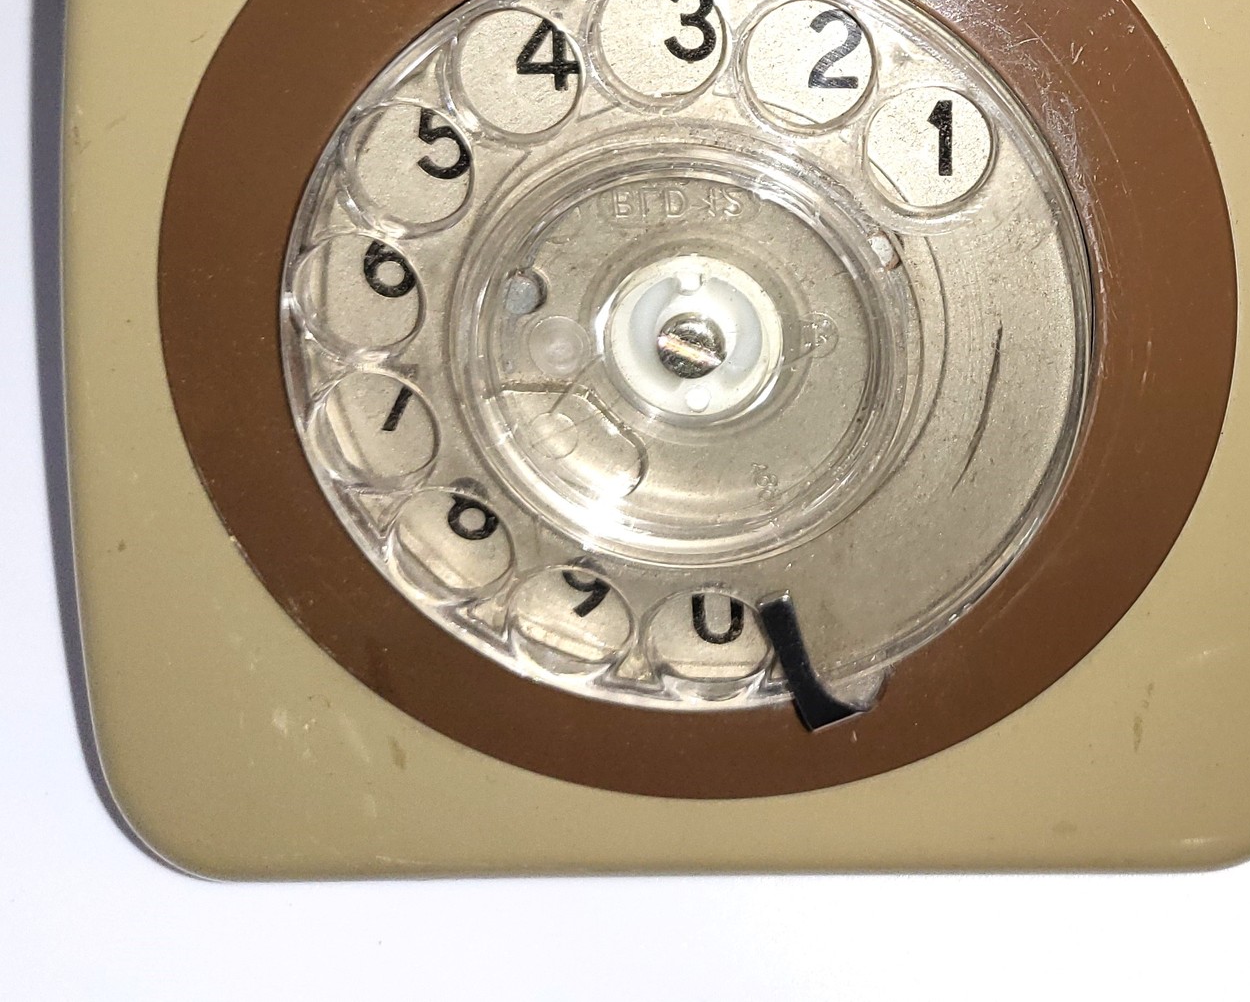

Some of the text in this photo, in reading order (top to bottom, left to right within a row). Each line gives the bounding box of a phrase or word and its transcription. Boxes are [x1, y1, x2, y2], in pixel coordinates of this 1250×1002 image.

[516, 18, 579, 91] 4
[808, 9, 863, 89] 2
[418, 108, 473, 180] 5
[928, 99, 954, 177] 1
[363, 238, 418, 298] 6
